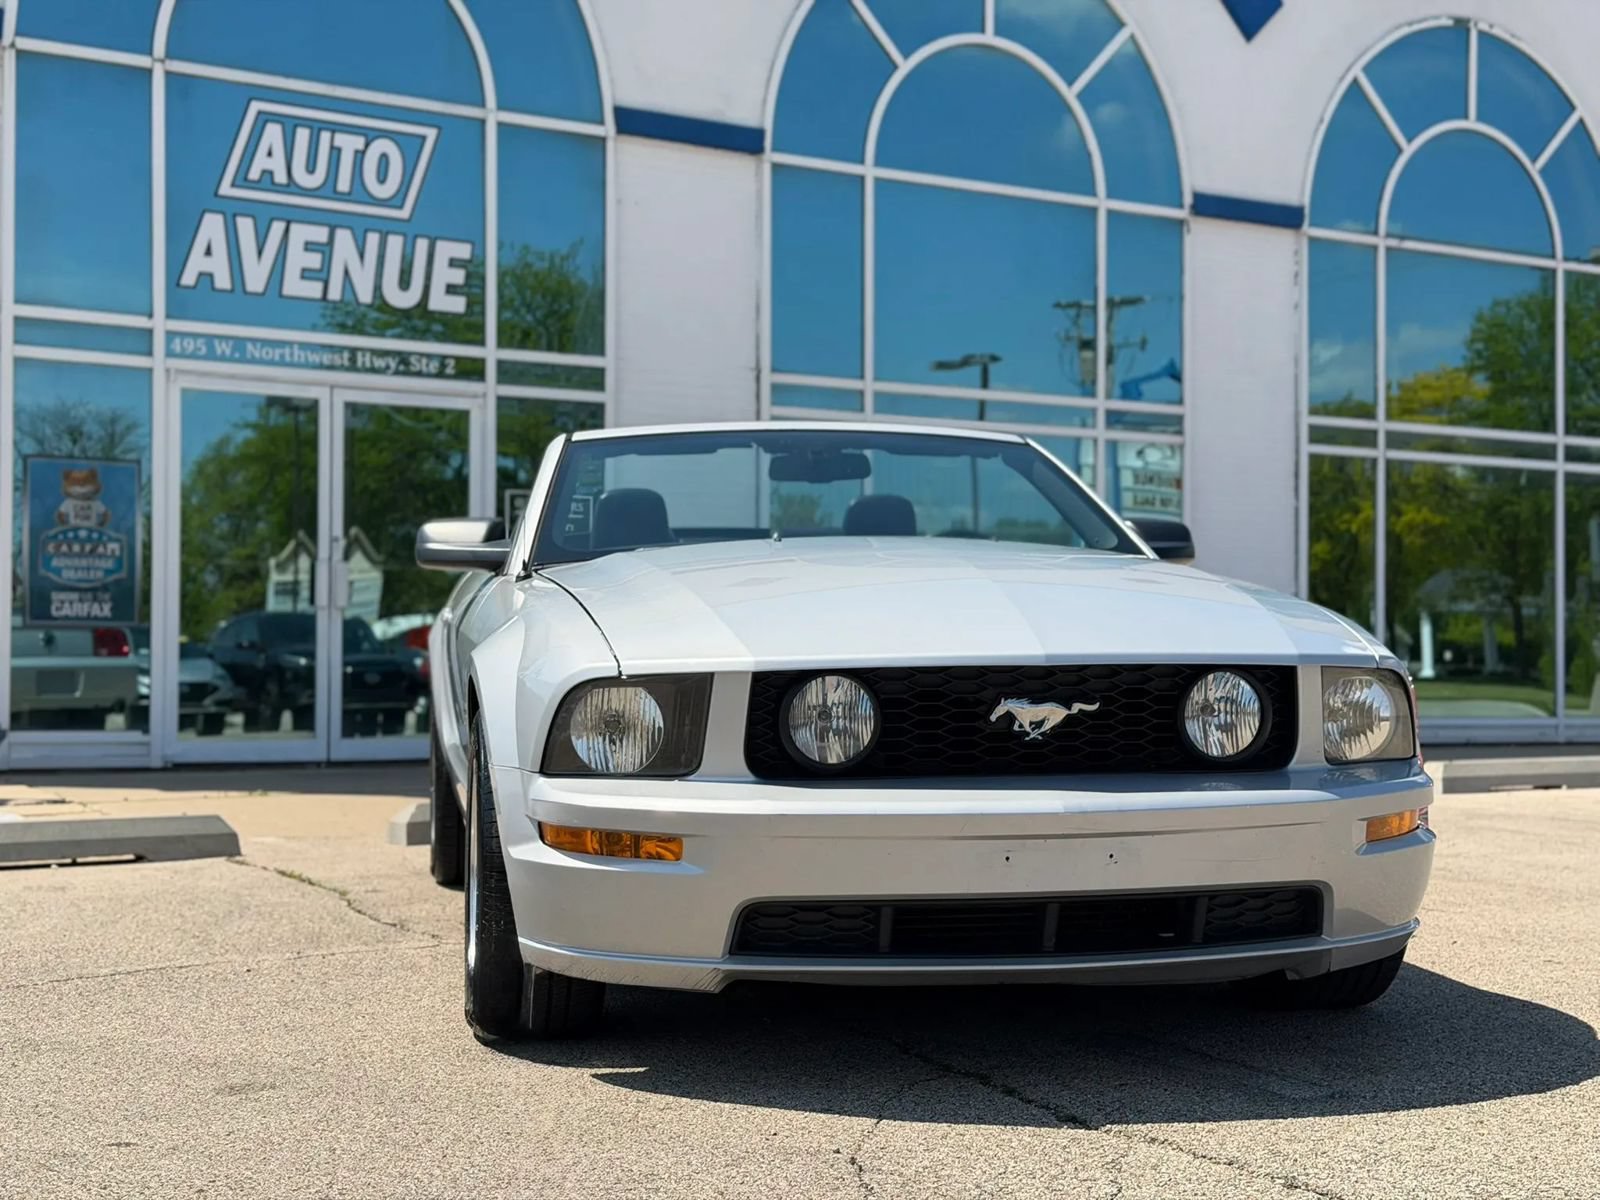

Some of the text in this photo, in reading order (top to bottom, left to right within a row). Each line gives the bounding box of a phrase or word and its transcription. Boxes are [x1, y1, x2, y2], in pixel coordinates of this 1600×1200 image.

[245, 120, 405, 201] AUTO
[178, 210, 474, 315] AVENUE
[169, 336, 457, 376] 495 W. Northwest Hwy. Ste 2
[51, 601, 113, 618] CARFAX
